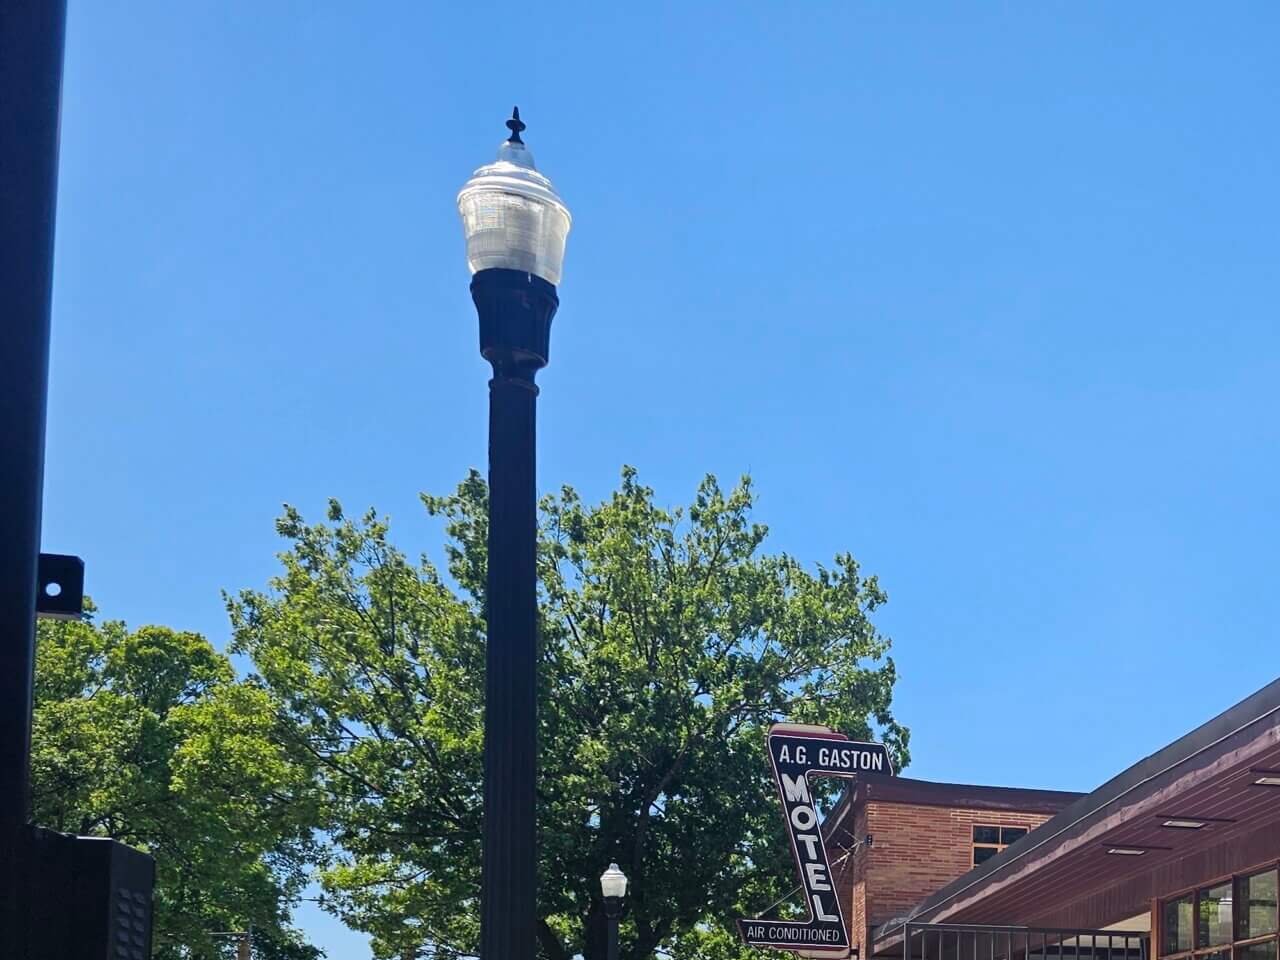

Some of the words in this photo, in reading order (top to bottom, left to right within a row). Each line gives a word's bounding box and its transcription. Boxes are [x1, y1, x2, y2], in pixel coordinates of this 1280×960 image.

[780, 745, 811, 765] A.G.
[819, 747, 883, 771] GASTON
[781, 773, 839, 923] MOTEL
[747, 925, 765, 938] AIR
[769, 926, 840, 942] CONDITIONED
